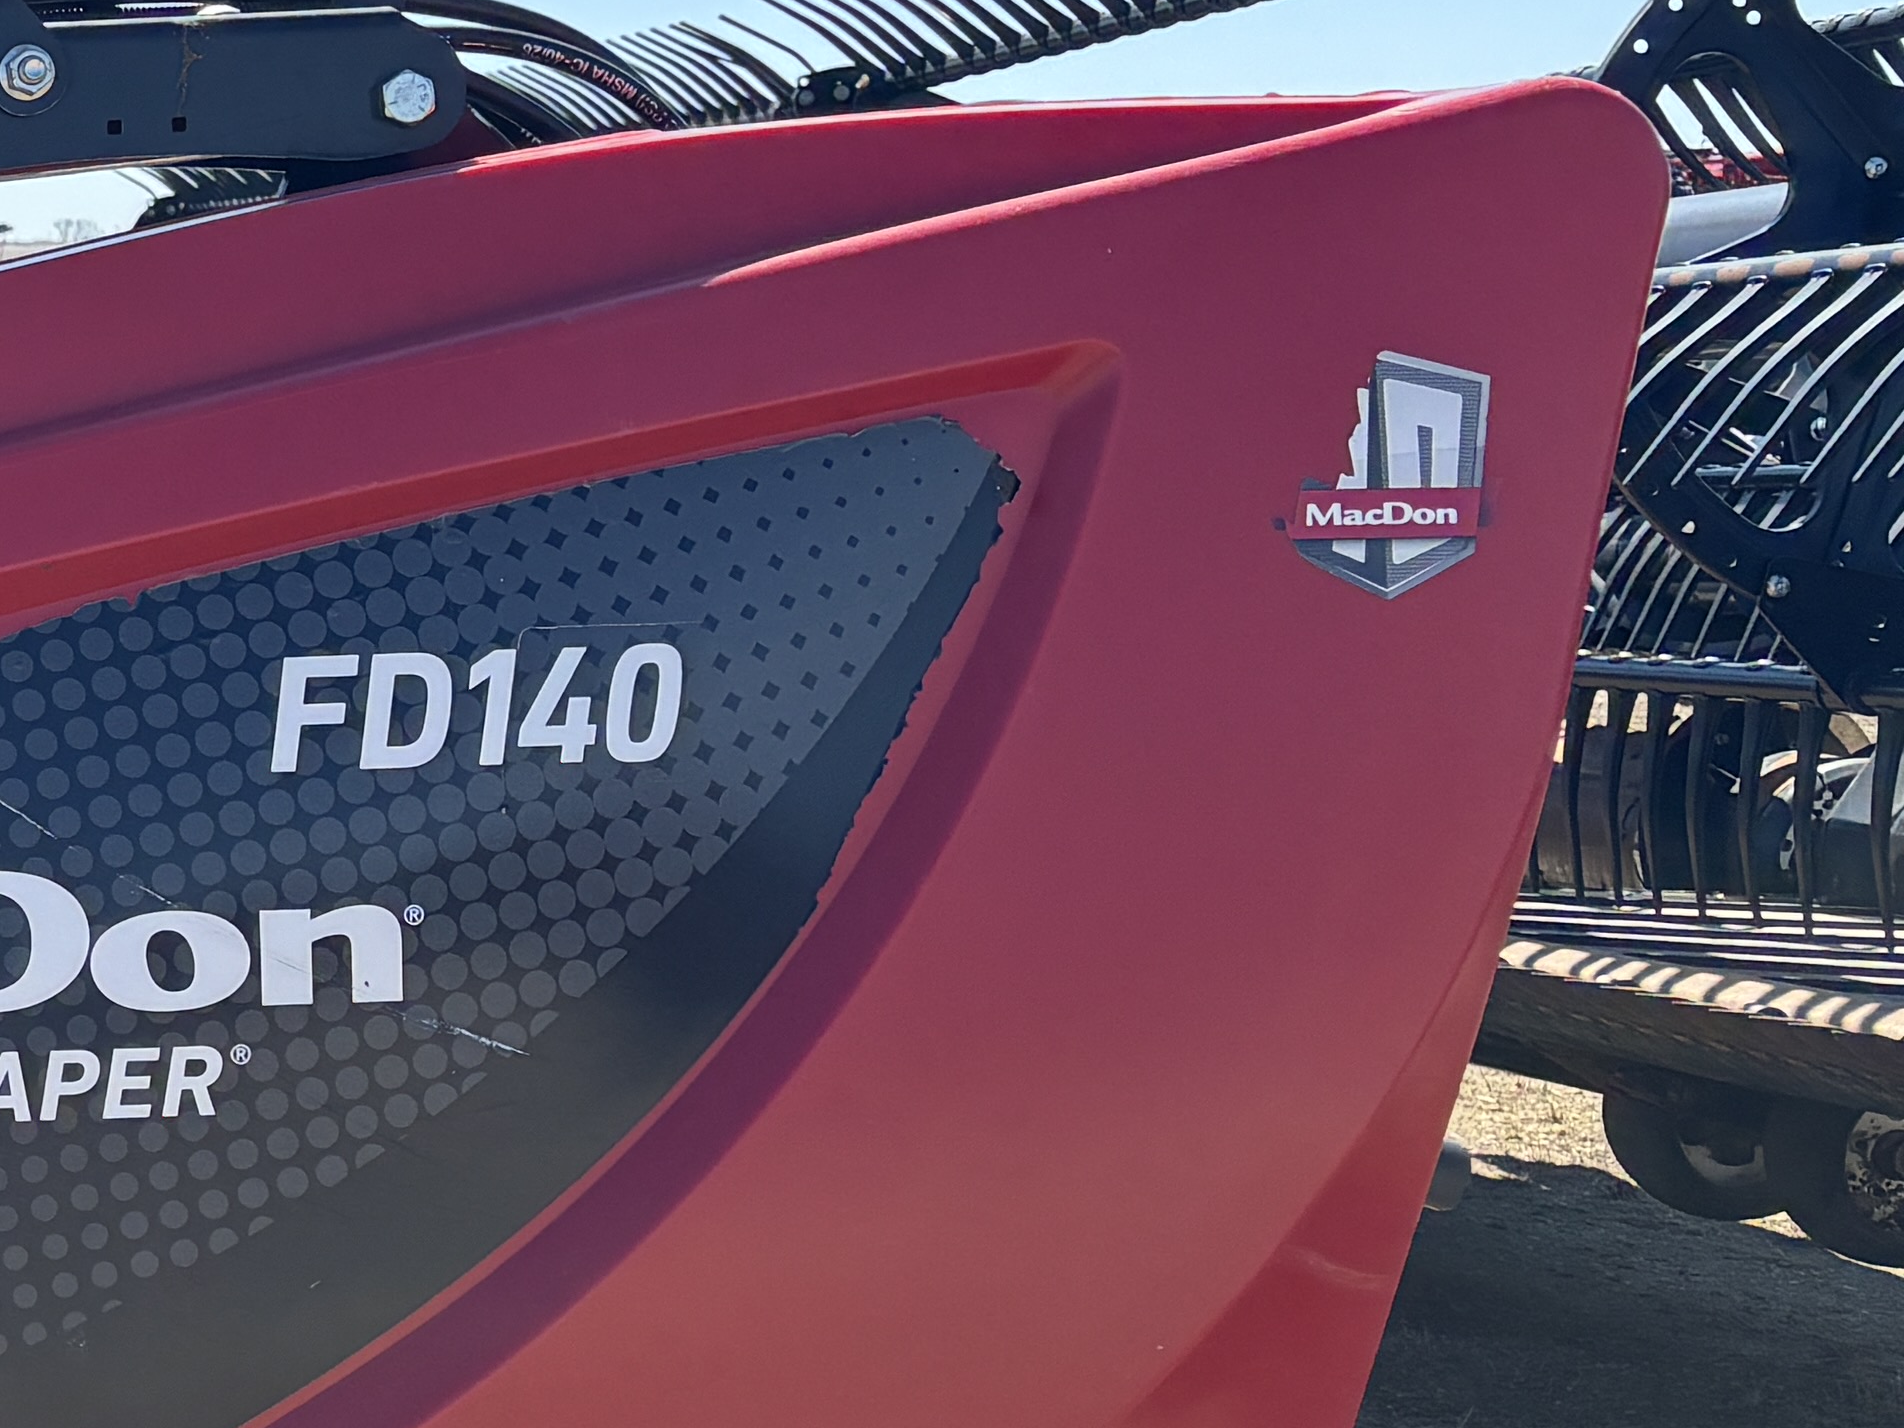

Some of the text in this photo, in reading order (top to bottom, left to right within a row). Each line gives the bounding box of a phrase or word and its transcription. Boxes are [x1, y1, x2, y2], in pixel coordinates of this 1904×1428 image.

[522, 43, 590, 74] IC-40/26
[592, 65, 638, 100] MSHA
[1305, 501, 1459, 527] MacDon
[270, 642, 683, 773] FD140
